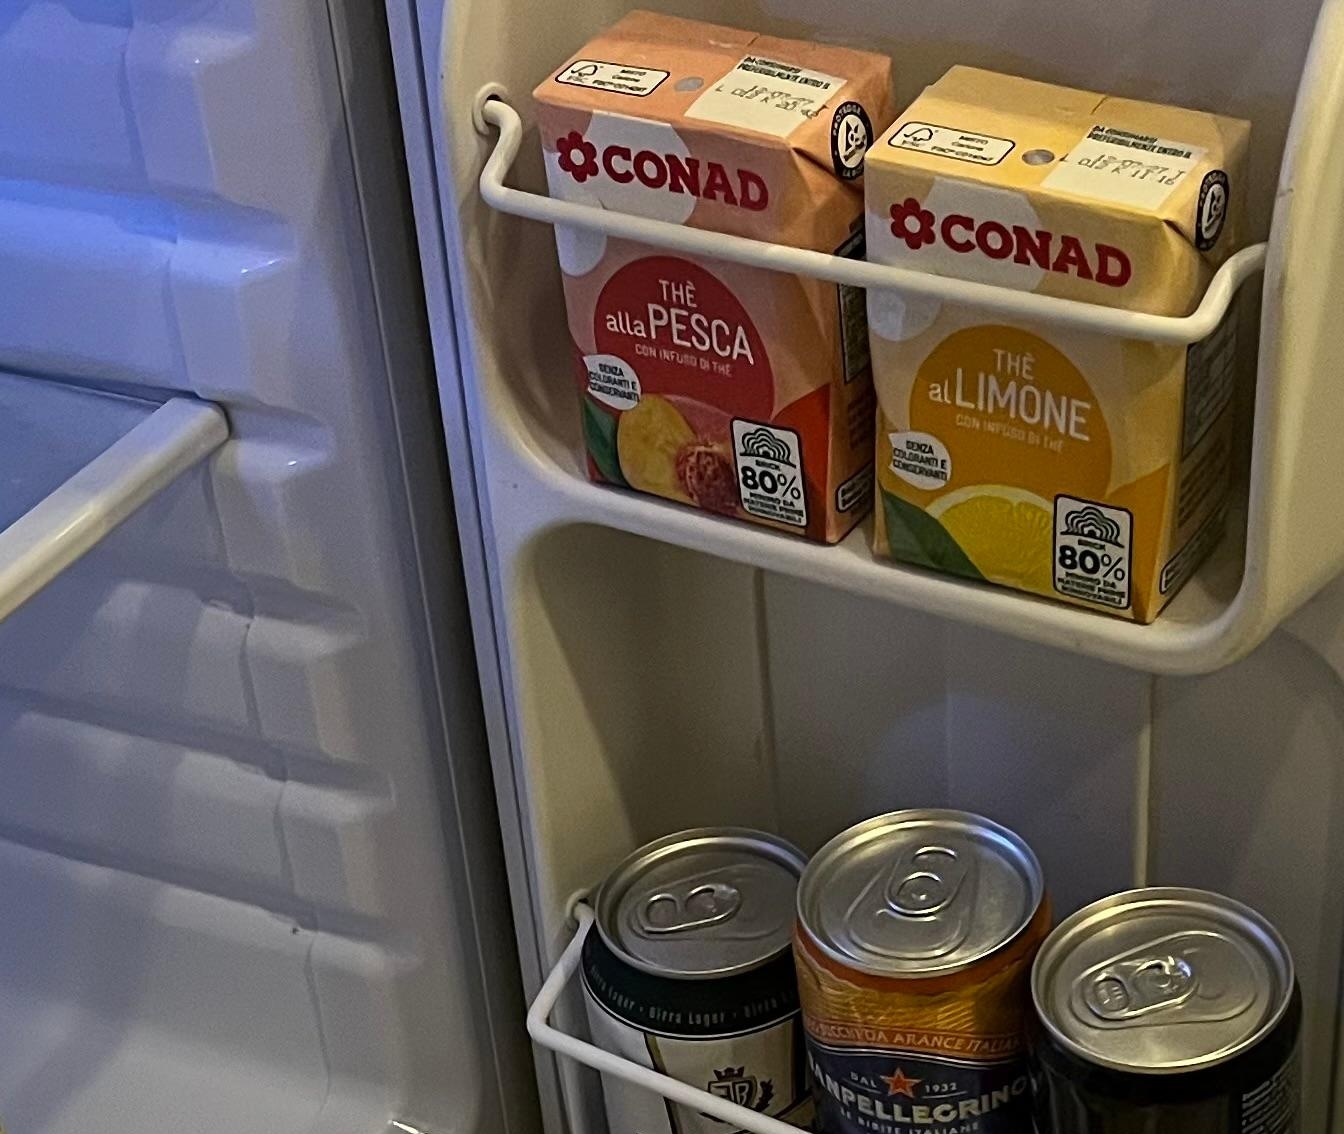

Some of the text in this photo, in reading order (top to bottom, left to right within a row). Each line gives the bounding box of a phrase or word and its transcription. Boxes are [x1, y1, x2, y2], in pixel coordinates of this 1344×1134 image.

[602, 145, 769, 211] CONAD
[941, 214, 1132, 287] CONAD
[659, 279, 697, 308] THÈ
[606, 303, 754, 365] alla PESCA
[992, 348, 1036, 380] THÈ
[929, 367, 1092, 442] al LIMONE
[741, 466, 801, 500] 80%
[1059, 545, 1126, 581] 80%
[893, 1031, 964, 1050] ARANCE
[850, 1070, 957, 1094] DAL 1932
